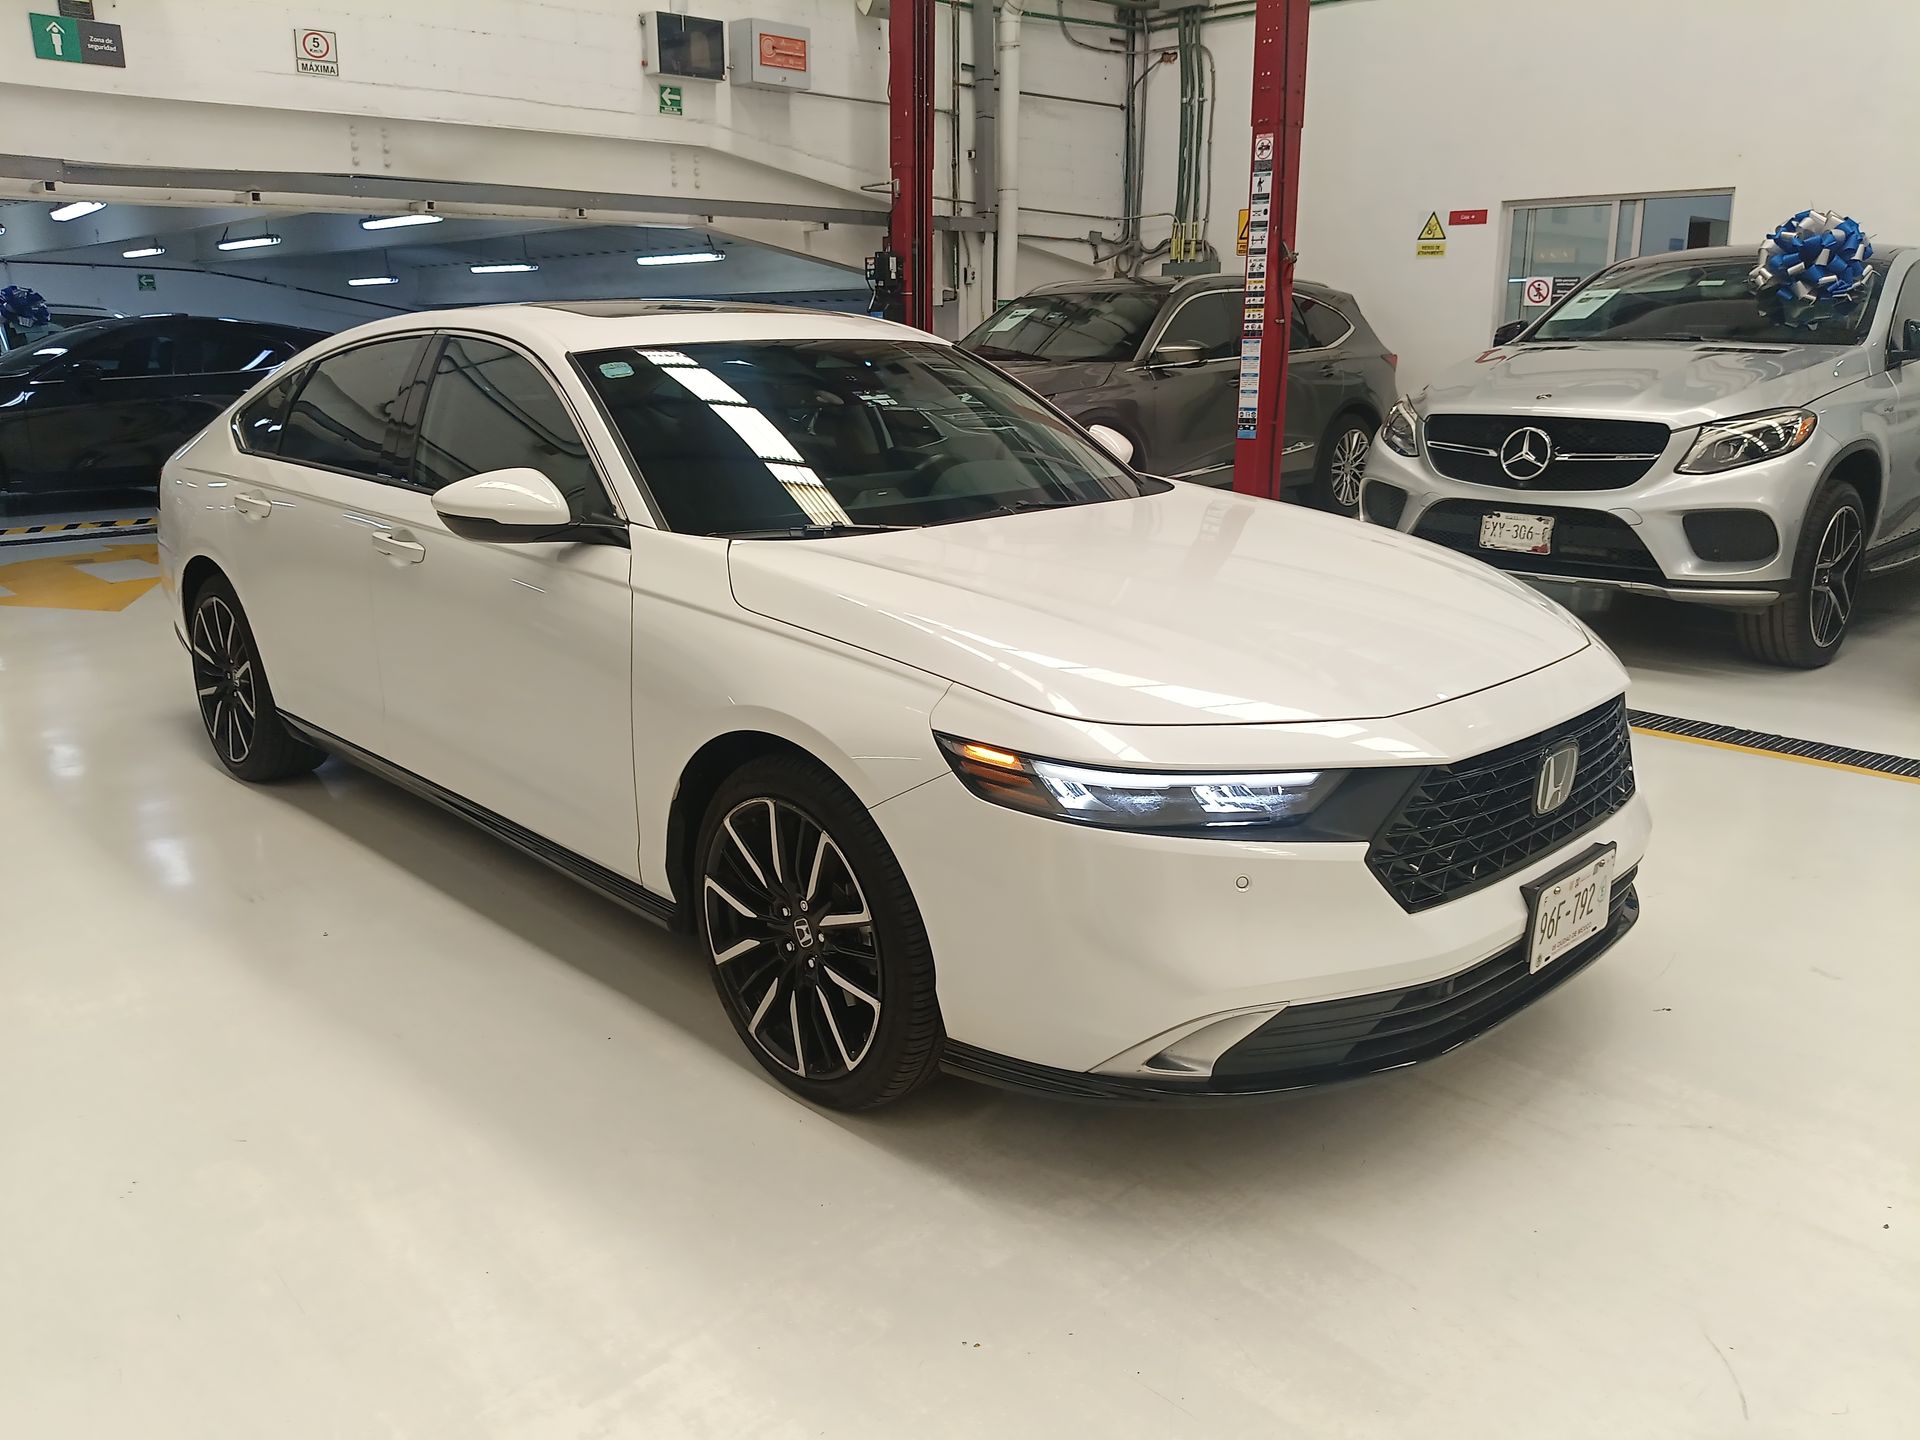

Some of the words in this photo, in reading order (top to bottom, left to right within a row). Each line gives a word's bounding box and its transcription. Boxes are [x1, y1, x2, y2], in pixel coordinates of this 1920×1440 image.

[88, 35, 104, 43] Zona
[312, 37, 320, 48] 5
[87, 43, 117, 52] seguridad
[301, 62, 336, 74] MÁXIMA
[1539, 883, 1596, 945] 96F-792
